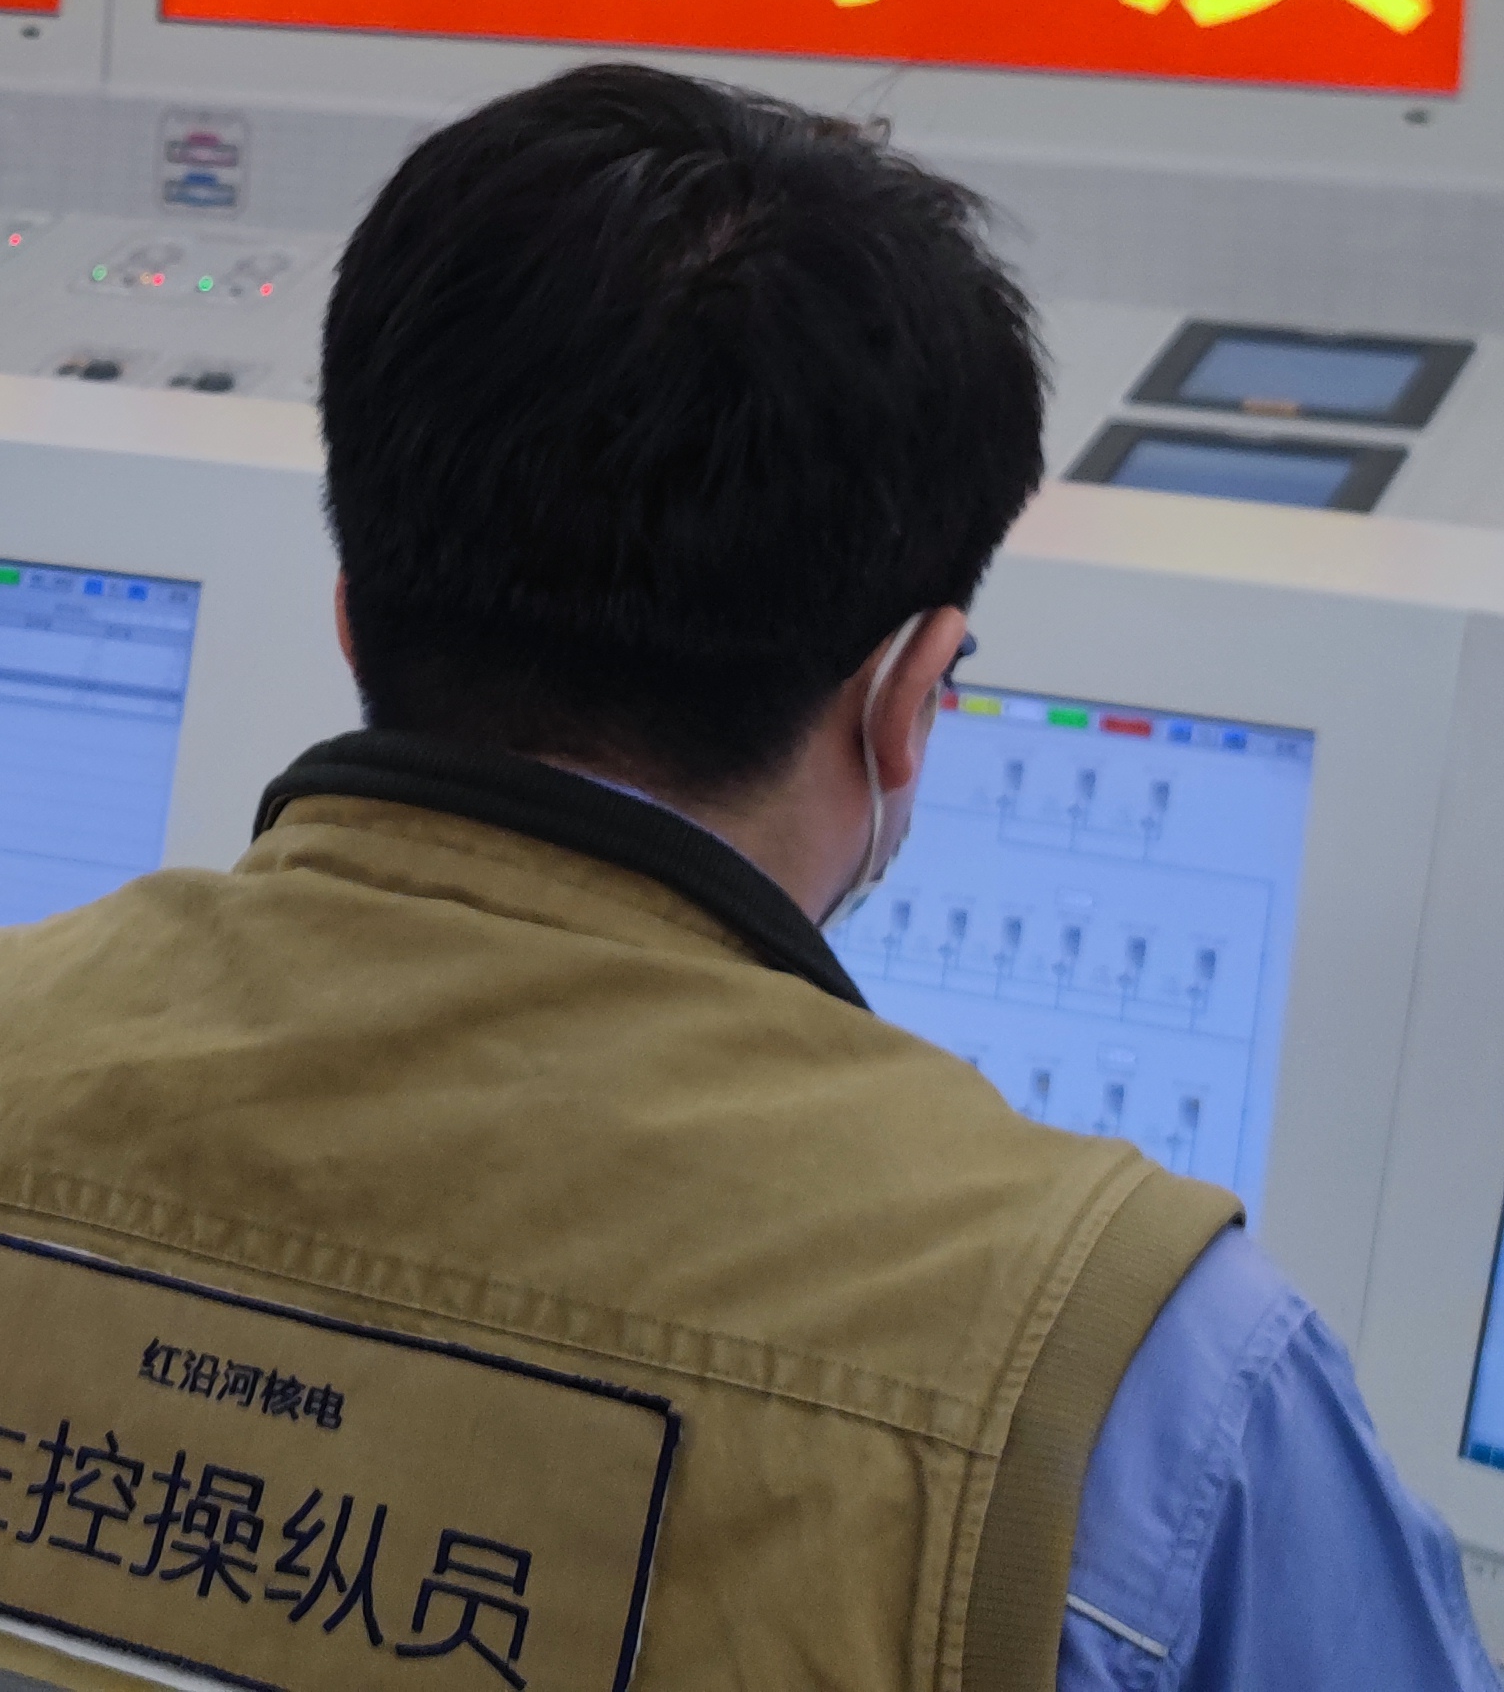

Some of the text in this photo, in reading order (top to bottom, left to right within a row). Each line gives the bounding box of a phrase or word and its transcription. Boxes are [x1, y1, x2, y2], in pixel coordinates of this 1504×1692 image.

[139, 1335, 346, 1432] 红沿河核电
